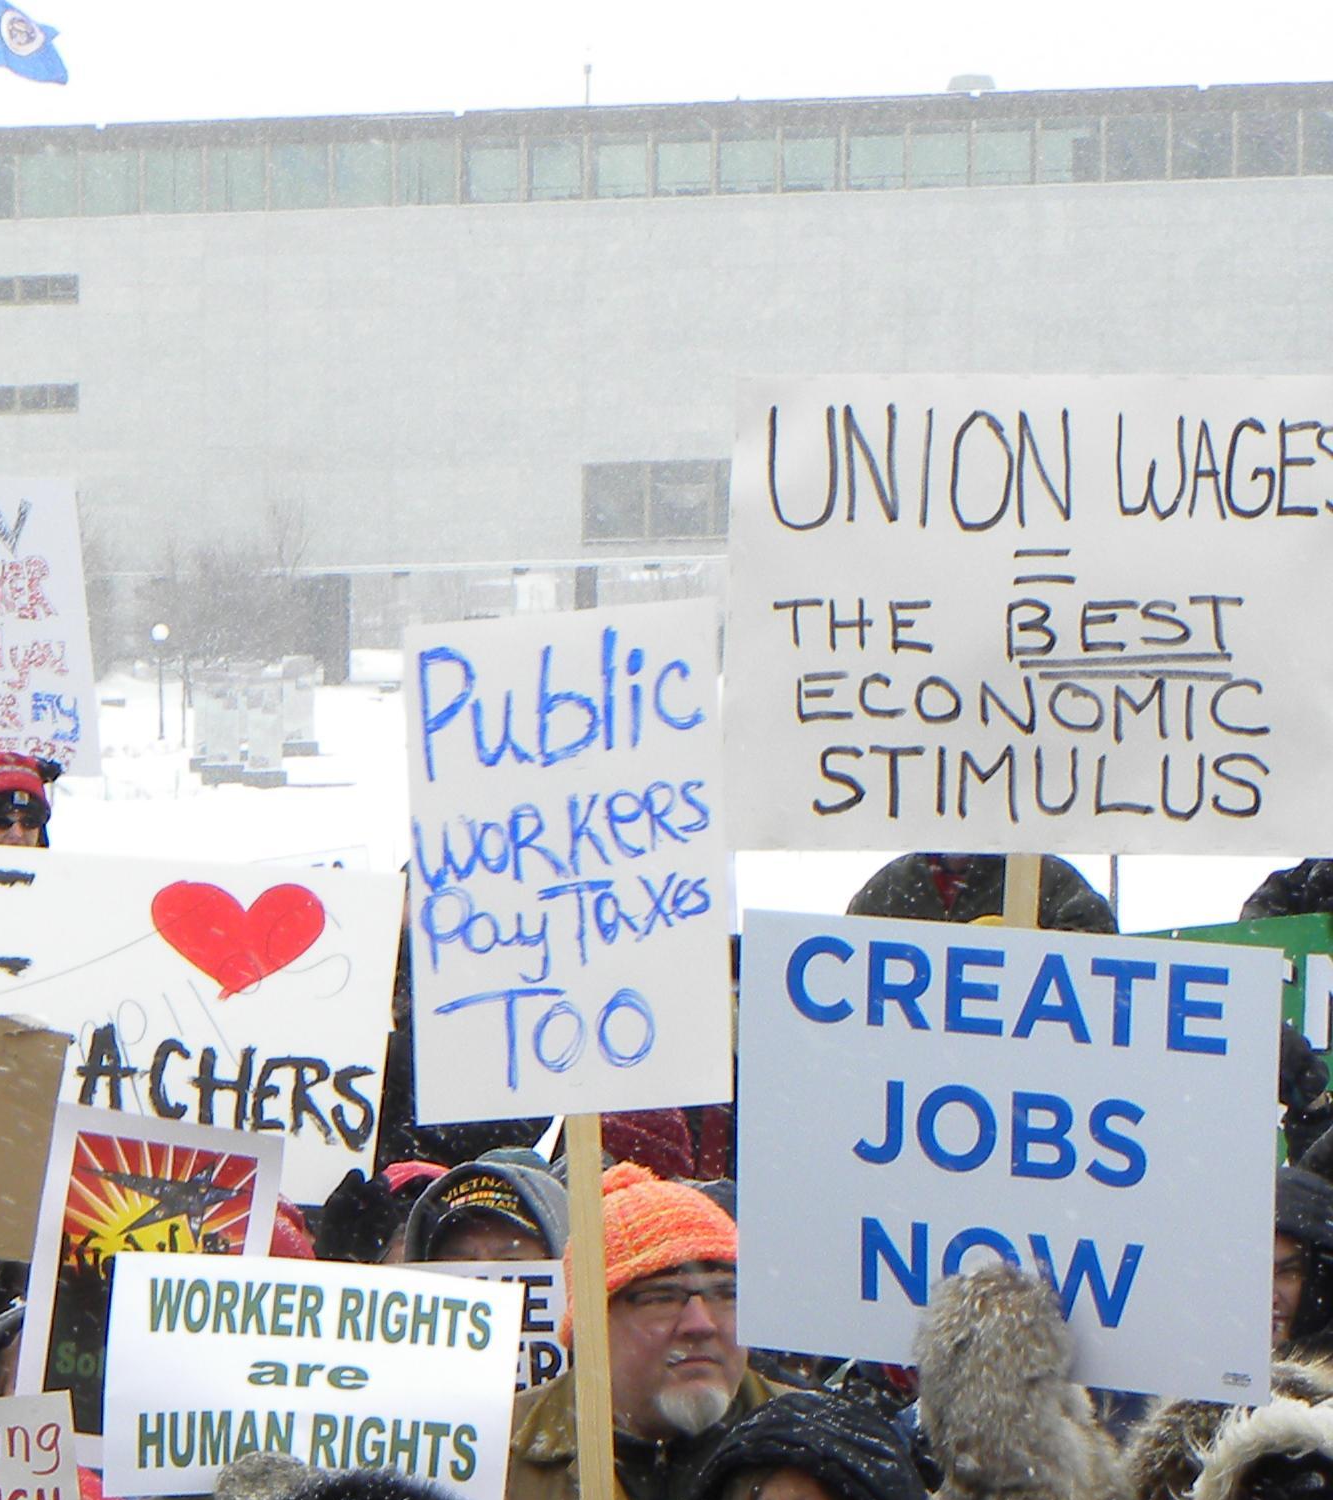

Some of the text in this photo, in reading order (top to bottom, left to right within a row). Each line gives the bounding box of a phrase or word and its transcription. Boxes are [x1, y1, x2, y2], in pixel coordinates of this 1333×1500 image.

[768, 403, 1072, 532] UNION
[773, 594, 1244, 662] THE BEST
[419, 625, 706, 782] Public
[796, 670, 1271, 744] ECONOMIC
[812, 745, 1271, 825] STIMULUS
[784, 934, 1231, 1057] CREATE
[434, 987, 654, 1094] TOO
[851, 1079, 1149, 1190] JOBS
[441, 1176, 514, 1203] VIETNA
[859, 1215, 1145, 1331] NOW
[149, 1277, 324, 1339] WORKER
[337, 1288, 492, 1351] RIGHTS
[247, 1360, 370, 1390] are
[137, 1410, 295, 1470] HUMAN
[309, 1413, 478, 1483] RIGHTS
